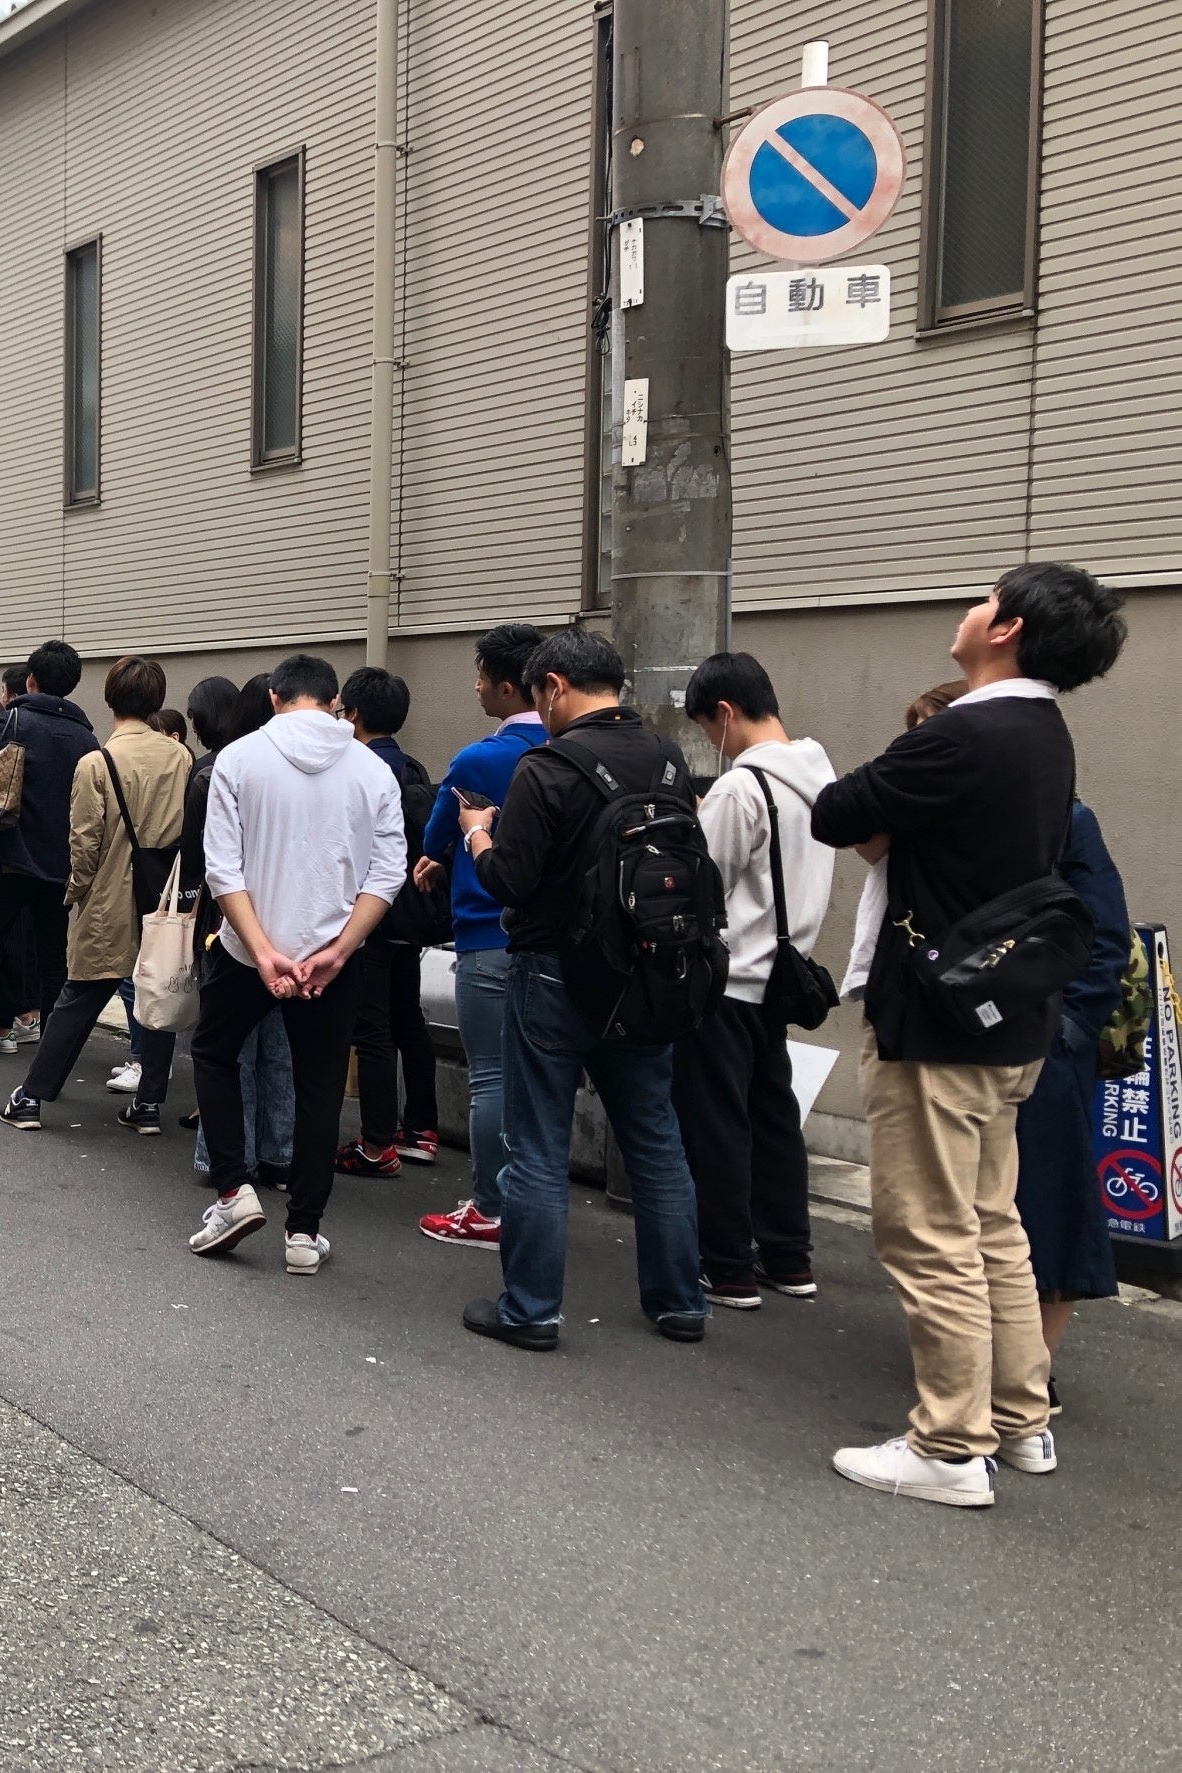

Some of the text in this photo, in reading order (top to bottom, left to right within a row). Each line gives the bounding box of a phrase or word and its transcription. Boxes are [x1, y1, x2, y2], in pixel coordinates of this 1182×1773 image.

[735, 274, 881, 315] 自動車
[1163, 986, 1172, 1021] NO
[1166, 1029, 1181, 1139] PARKING
[1102, 1080, 1120, 1137] RKING
[1107, 1218, 1146, 1233] 急電鉄
